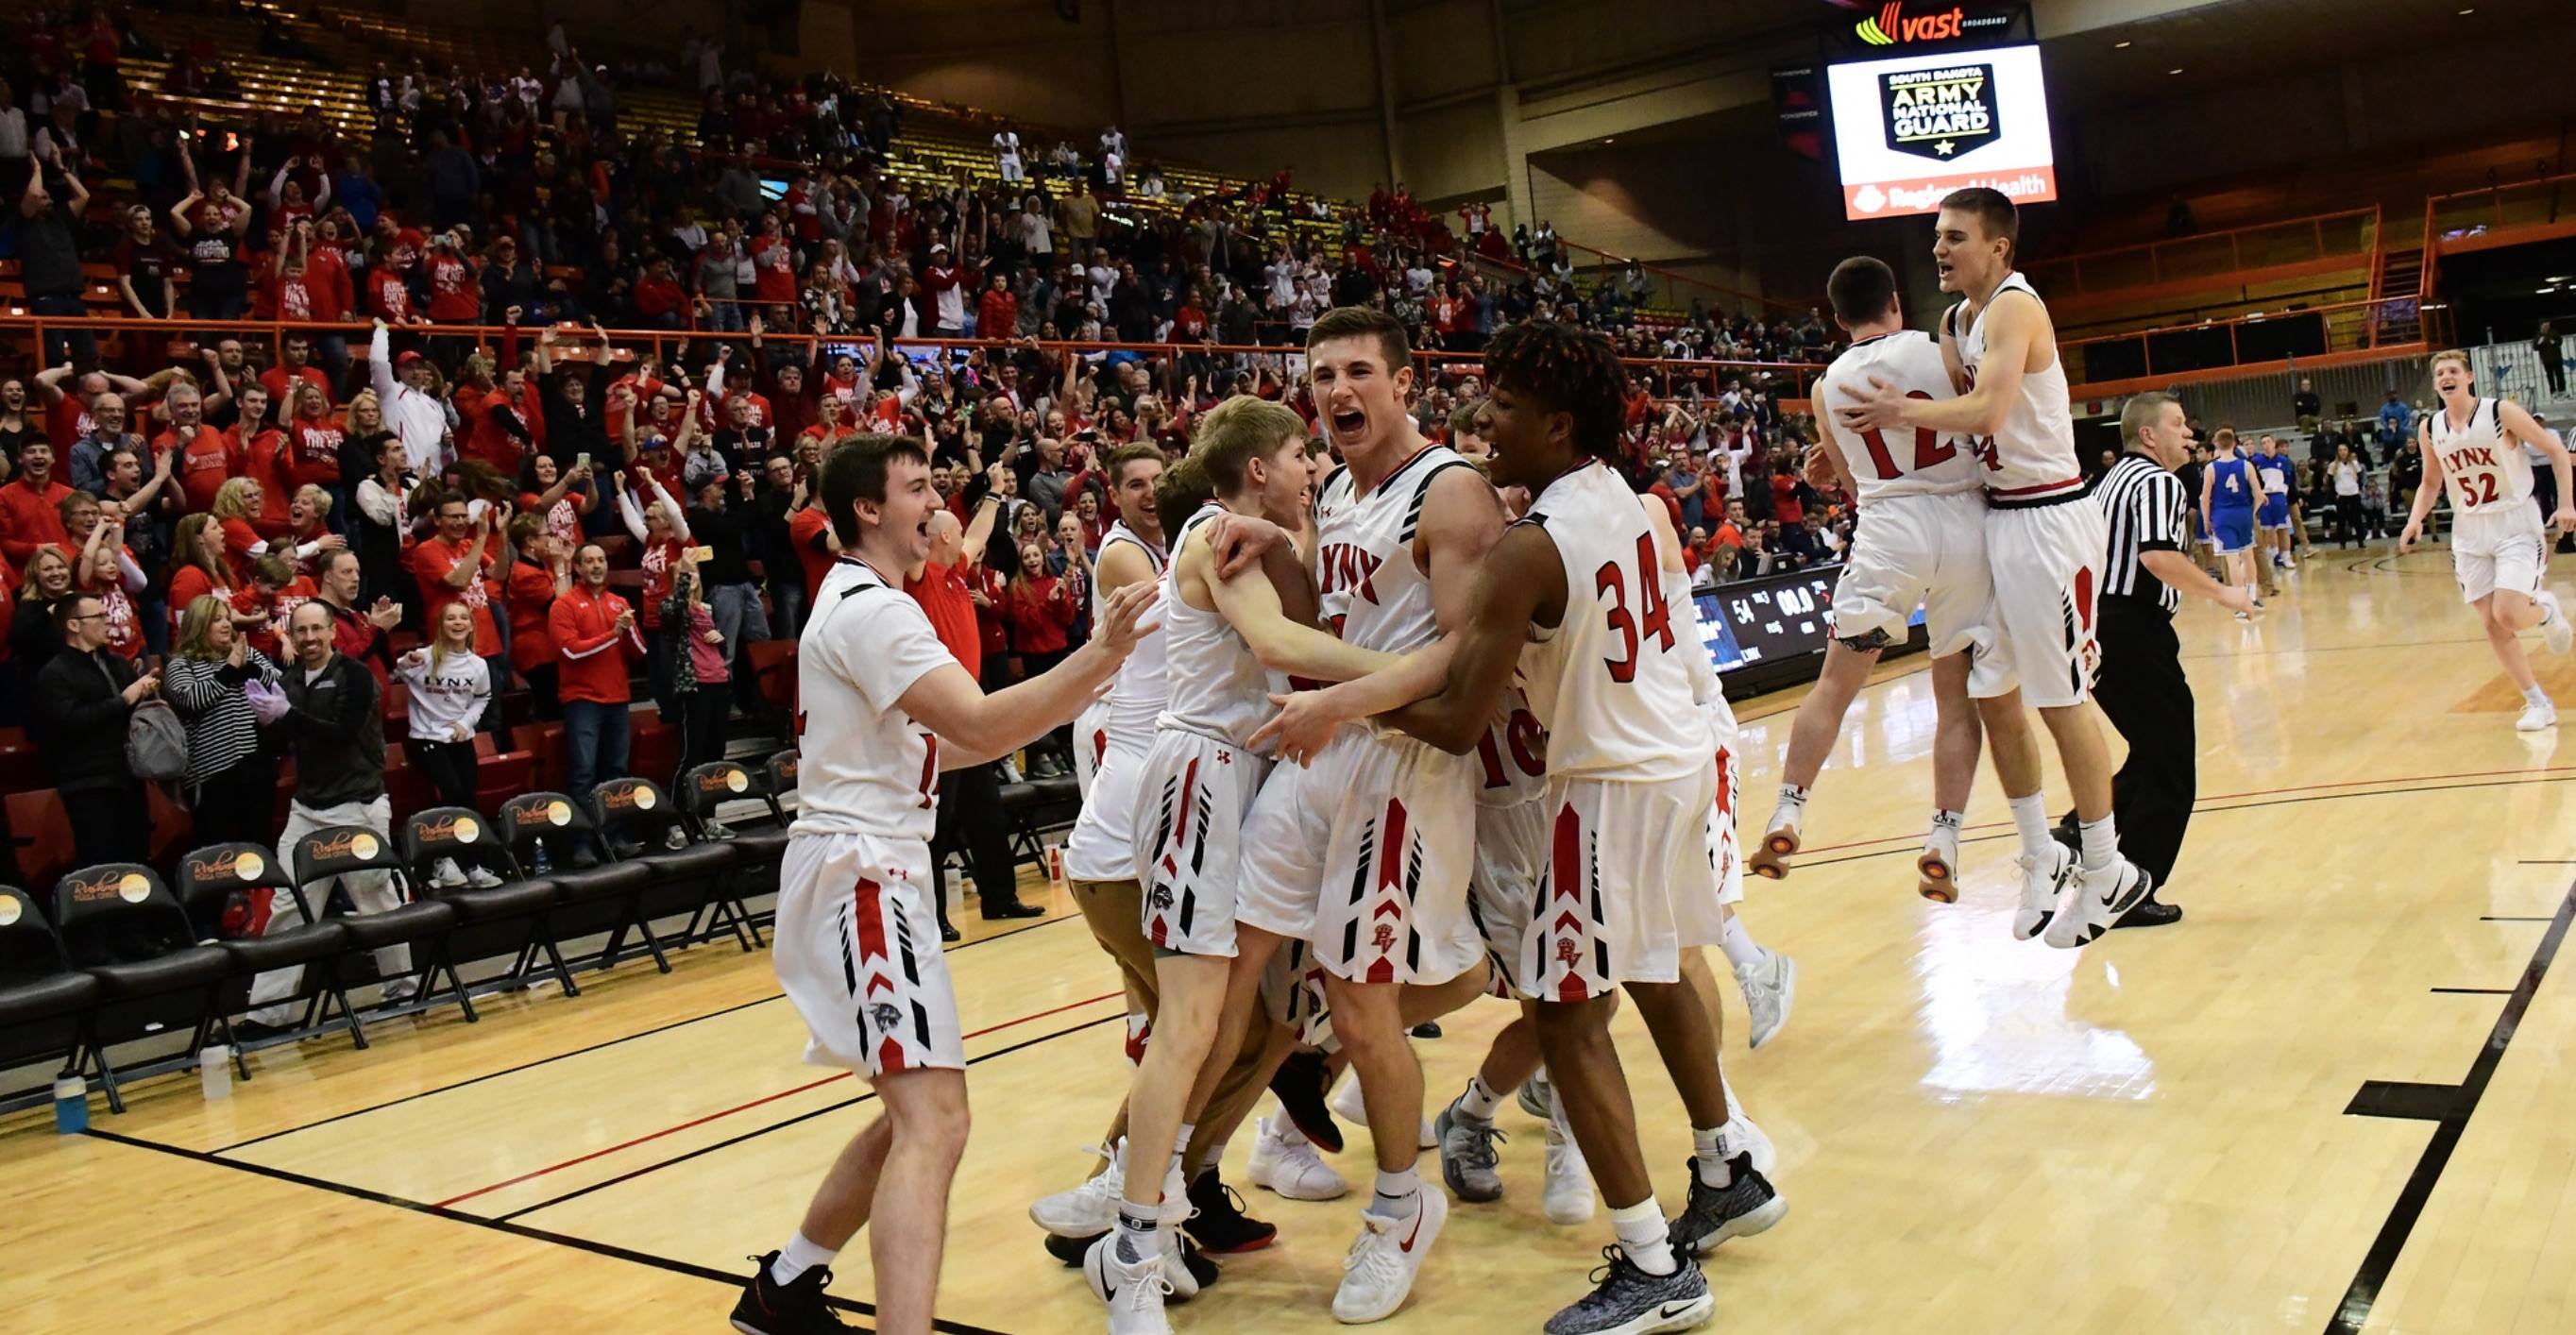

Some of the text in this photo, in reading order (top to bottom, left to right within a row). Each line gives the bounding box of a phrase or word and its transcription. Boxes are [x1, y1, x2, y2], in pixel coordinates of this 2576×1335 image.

[1902, 7, 2008, 42] vast BROADBAND
[1889, 67, 1983, 85] SOUTH DAKOTA
[1892, 81, 1983, 108] ARMY
[1892, 99, 1988, 120] NATIONAL
[1893, 112, 1990, 137] GUARD
[2443, 447, 2499, 474] LYNX
[2225, 473, 2240, 493] 4
[2457, 472, 2500, 508] 52
[1595, 529, 1676, 684] 34
[1732, 599, 1755, 625] 54
